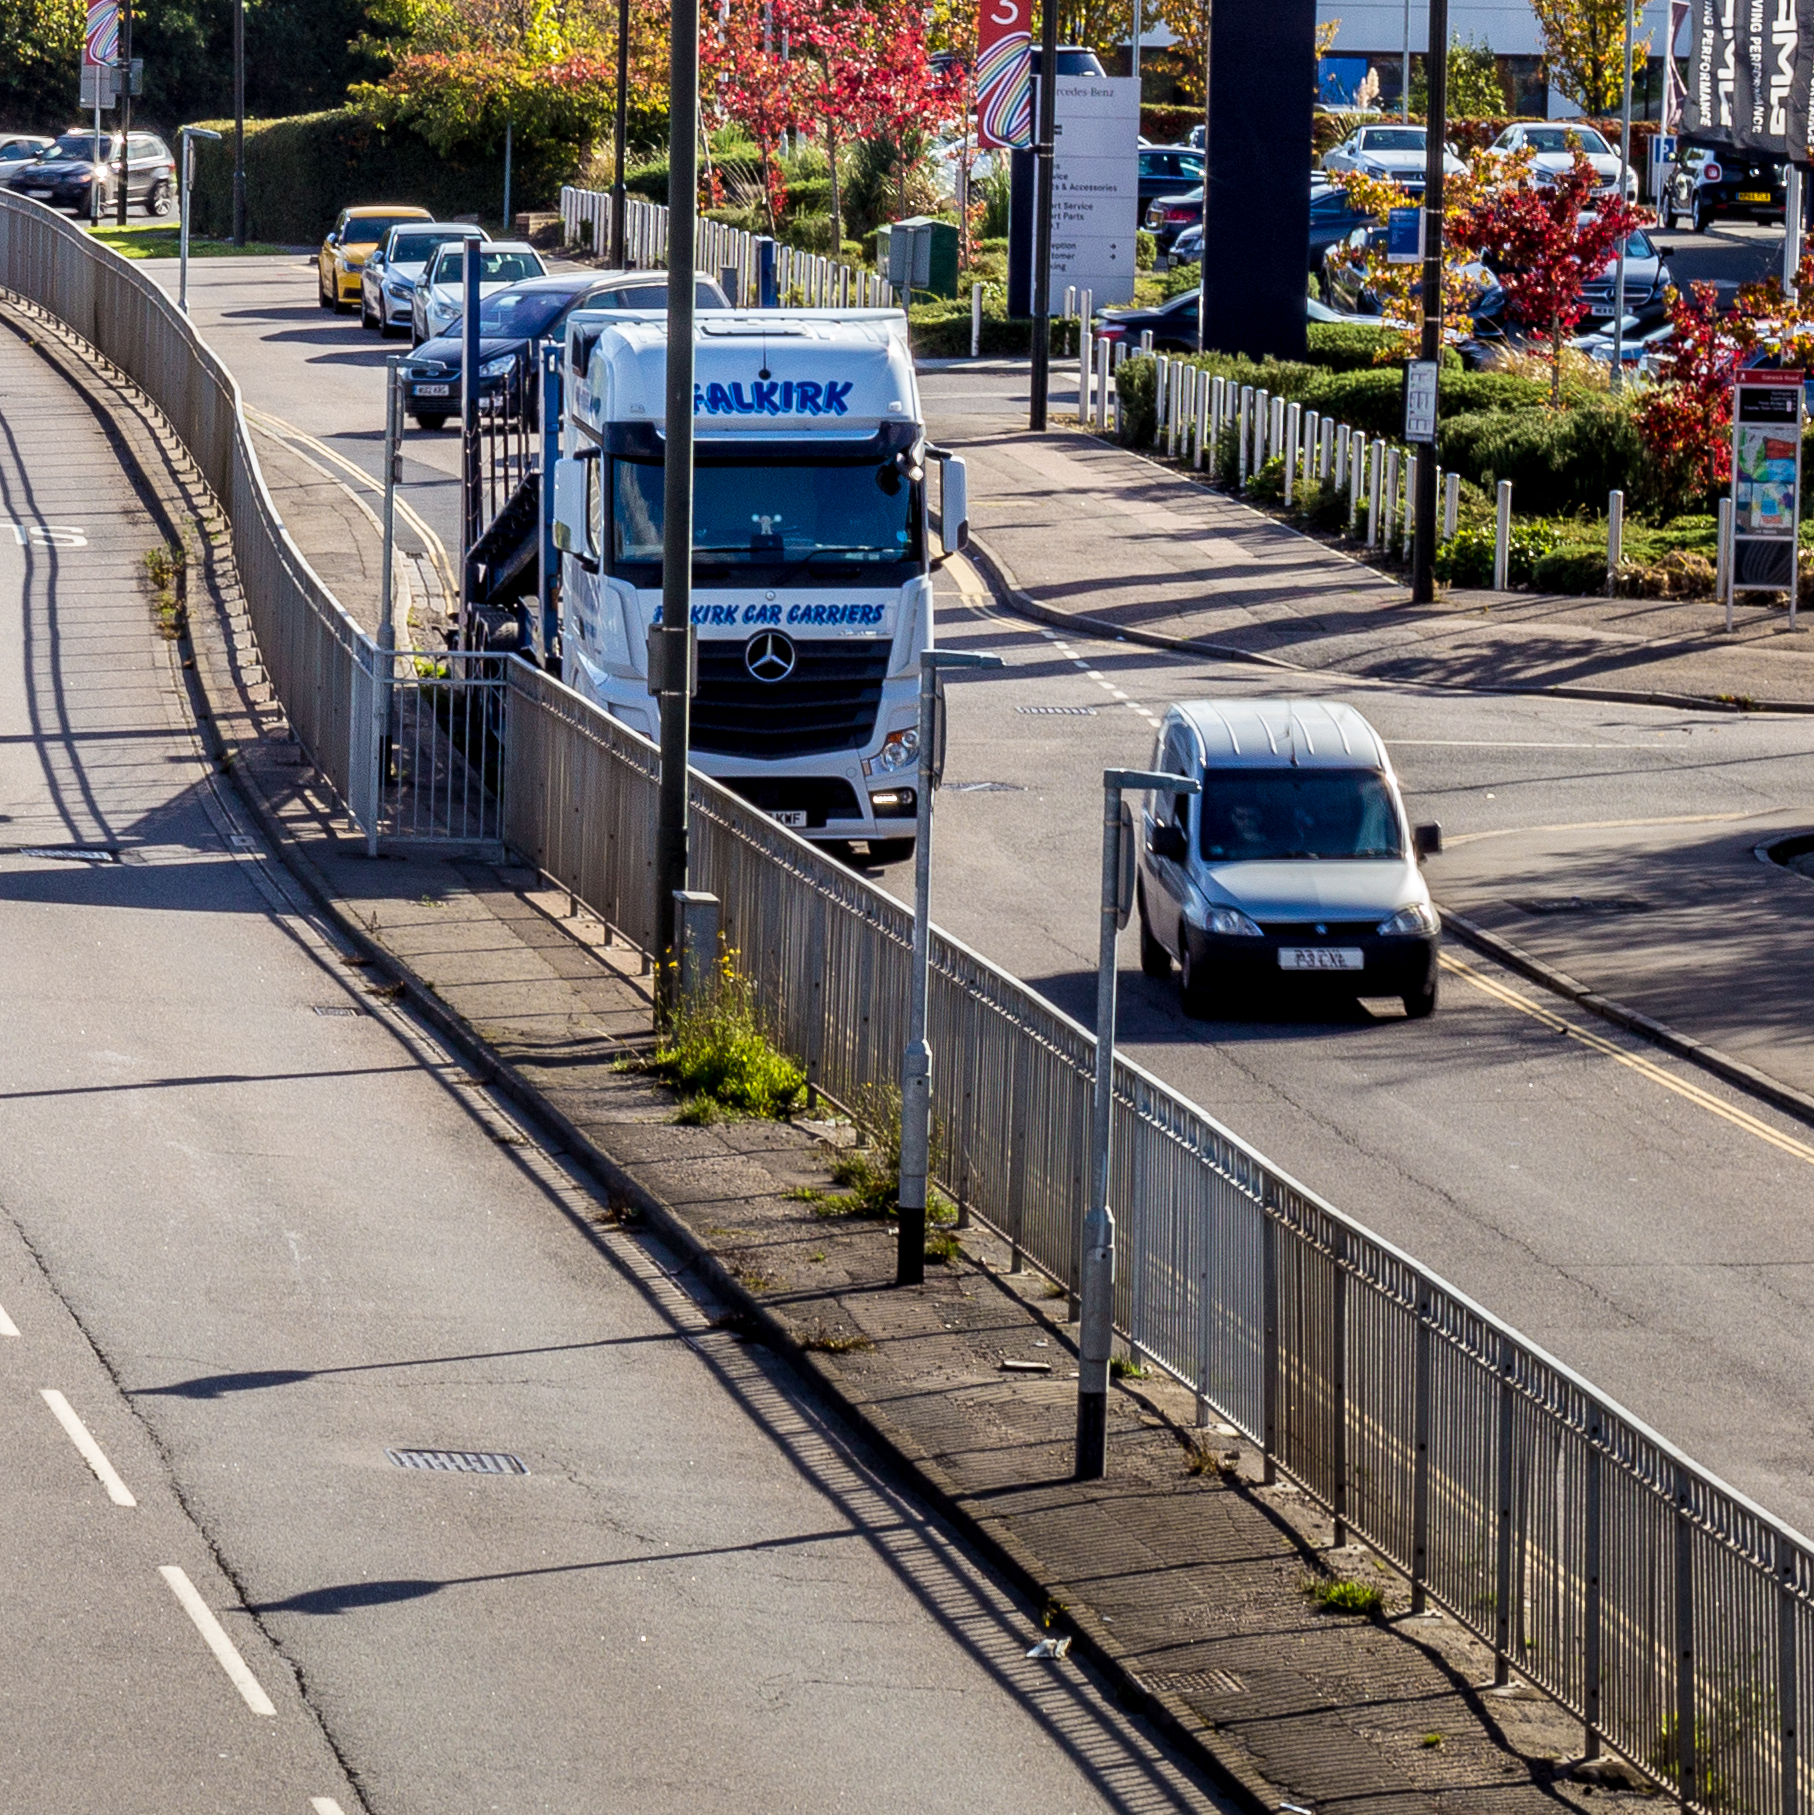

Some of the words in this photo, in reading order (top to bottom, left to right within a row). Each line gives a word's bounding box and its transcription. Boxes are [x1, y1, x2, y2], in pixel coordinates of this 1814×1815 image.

[1698, 28, 1715, 128] PERFORMANCE
[1056, 86, 1114, 98] rcedes-Benz
[1069, 183, 1118, 193] Accessories
[1063, 202, 1094, 211] Service
[1063, 212, 1085, 221] Parts
[742, 604, 783, 625] CAR
[785, 604, 885, 625] CARRIERS
